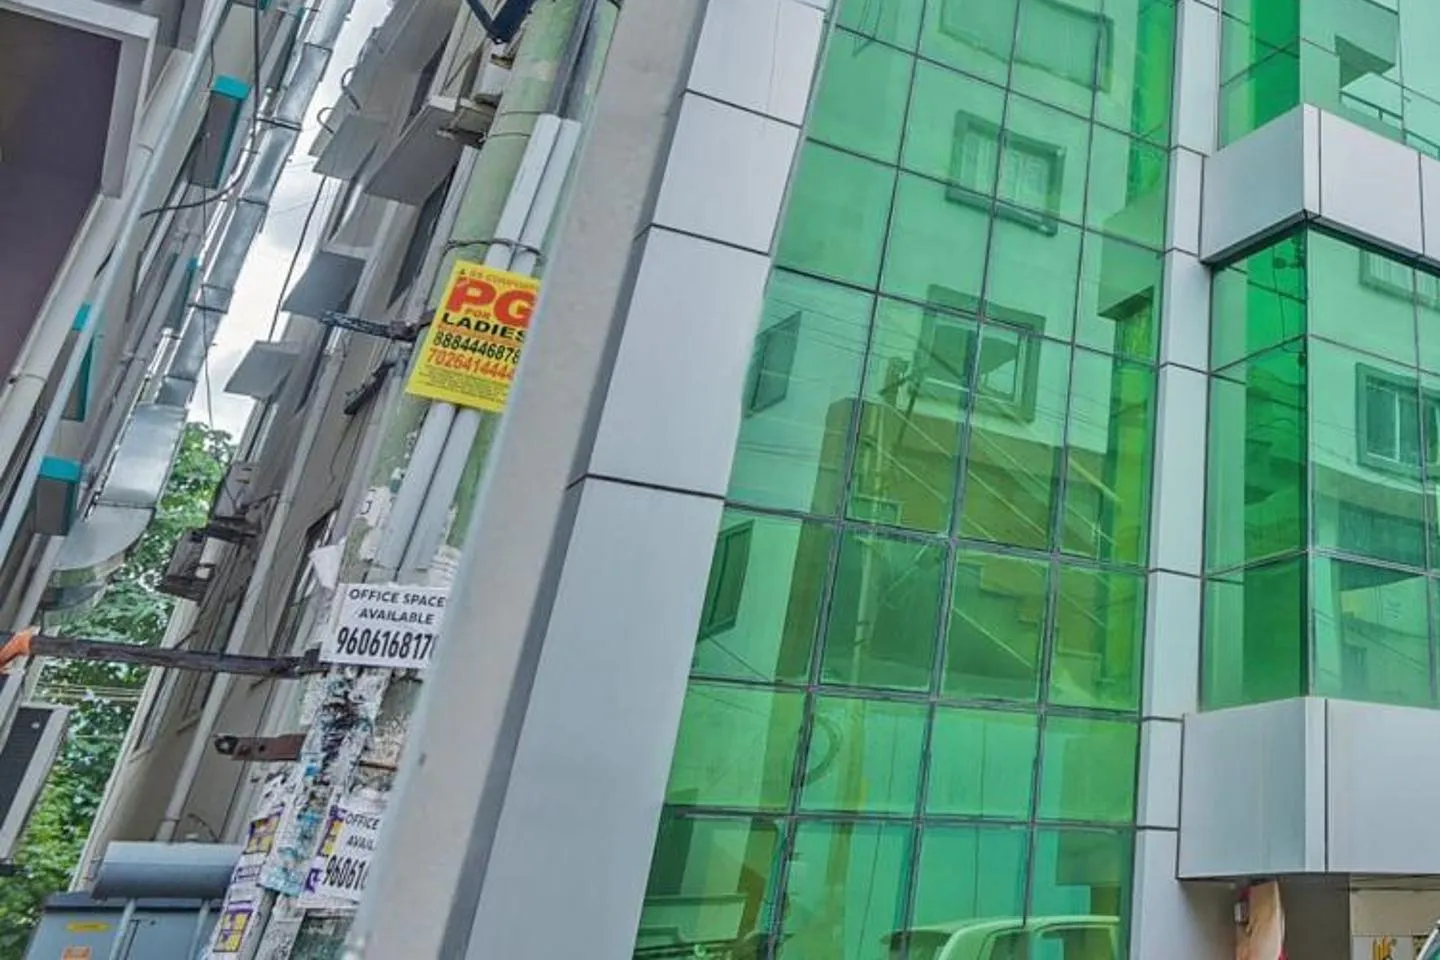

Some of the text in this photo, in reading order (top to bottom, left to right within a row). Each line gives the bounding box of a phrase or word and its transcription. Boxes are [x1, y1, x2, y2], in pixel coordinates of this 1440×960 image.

[446, 277, 537, 328] PG
[442, 312, 526, 342] LADIES
[348, 588, 447, 608] OFFICE SPACE
[358, 607, 435, 625] AVAILABLE
[346, 813, 381, 831] OFFICE
[347, 835, 375, 851] AVAIL
